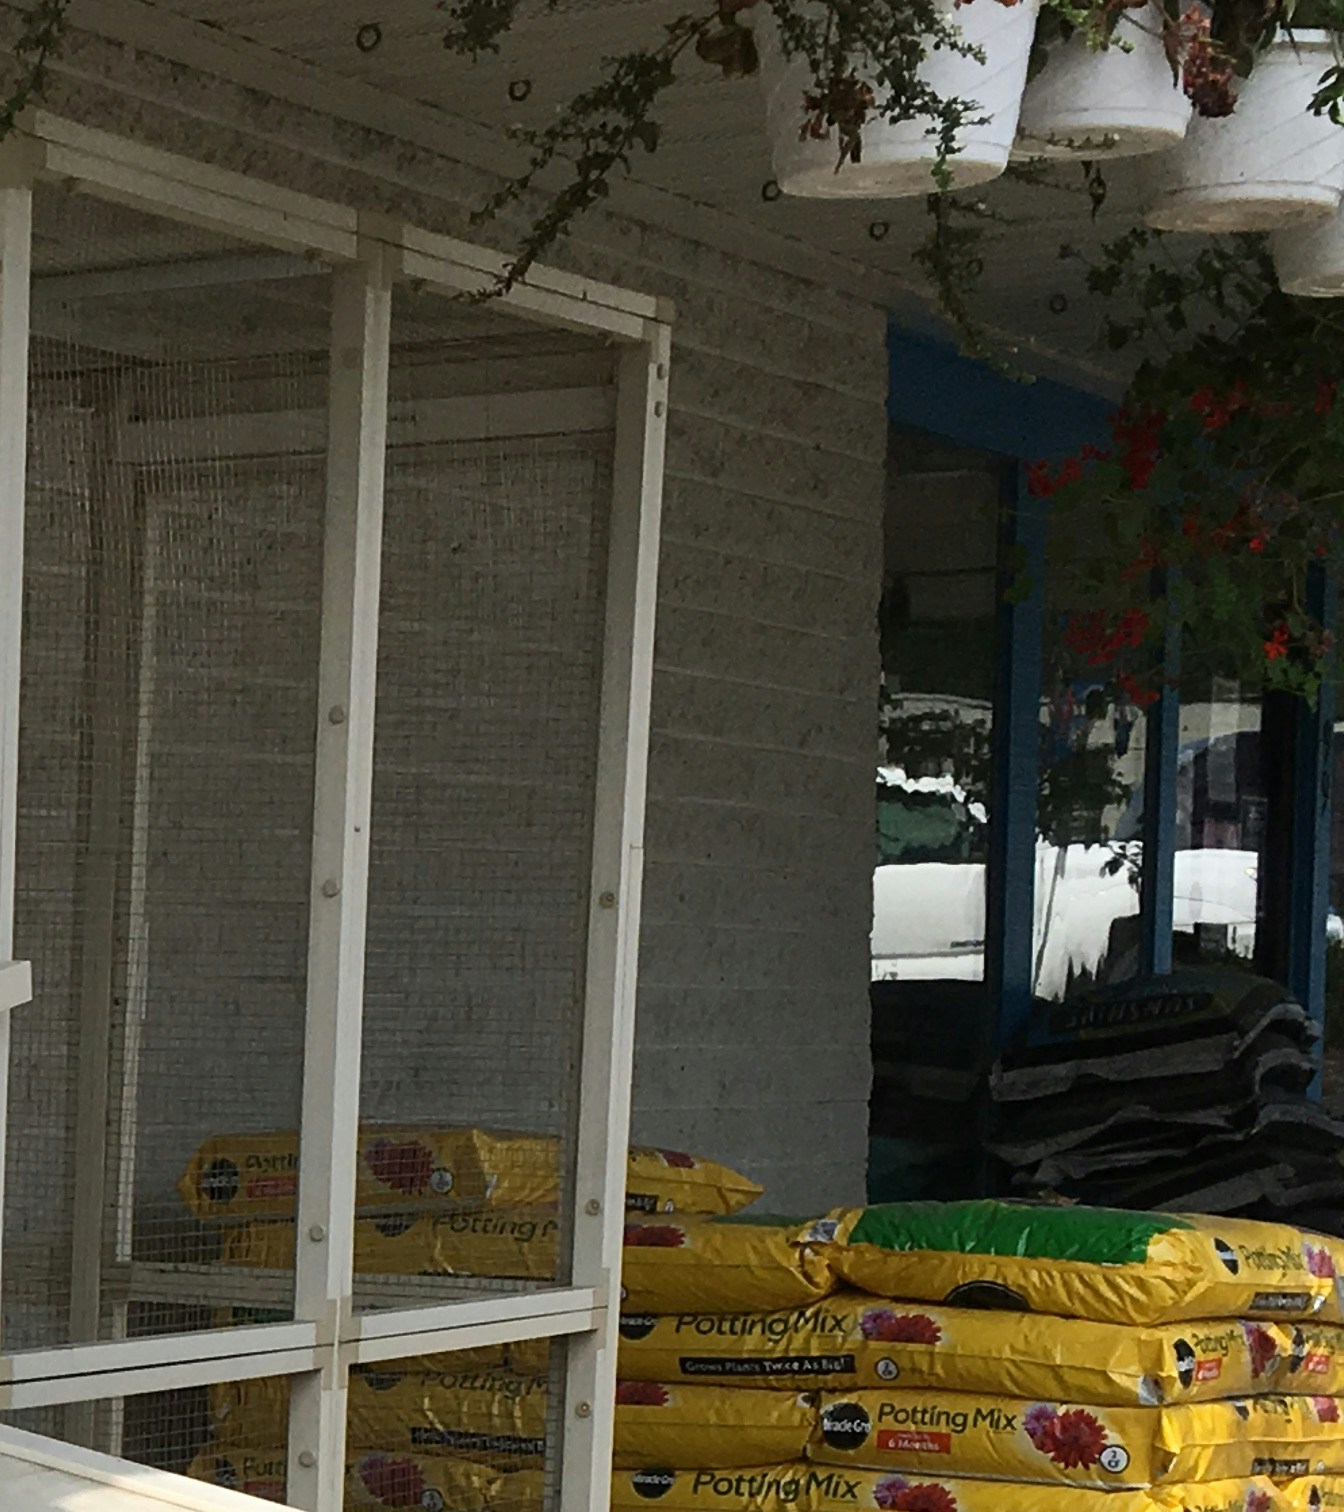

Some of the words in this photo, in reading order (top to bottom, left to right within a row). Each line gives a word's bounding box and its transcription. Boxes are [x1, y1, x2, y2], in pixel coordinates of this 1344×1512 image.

[675, 1311, 788, 1342] Potting
[793, 1309, 849, 1336] Mix
[877, 1402, 968, 1433] Potting
[972, 1407, 1017, 1431] Mix
[692, 1471, 800, 1503] Potting
[805, 1471, 862, 1500] Mix
